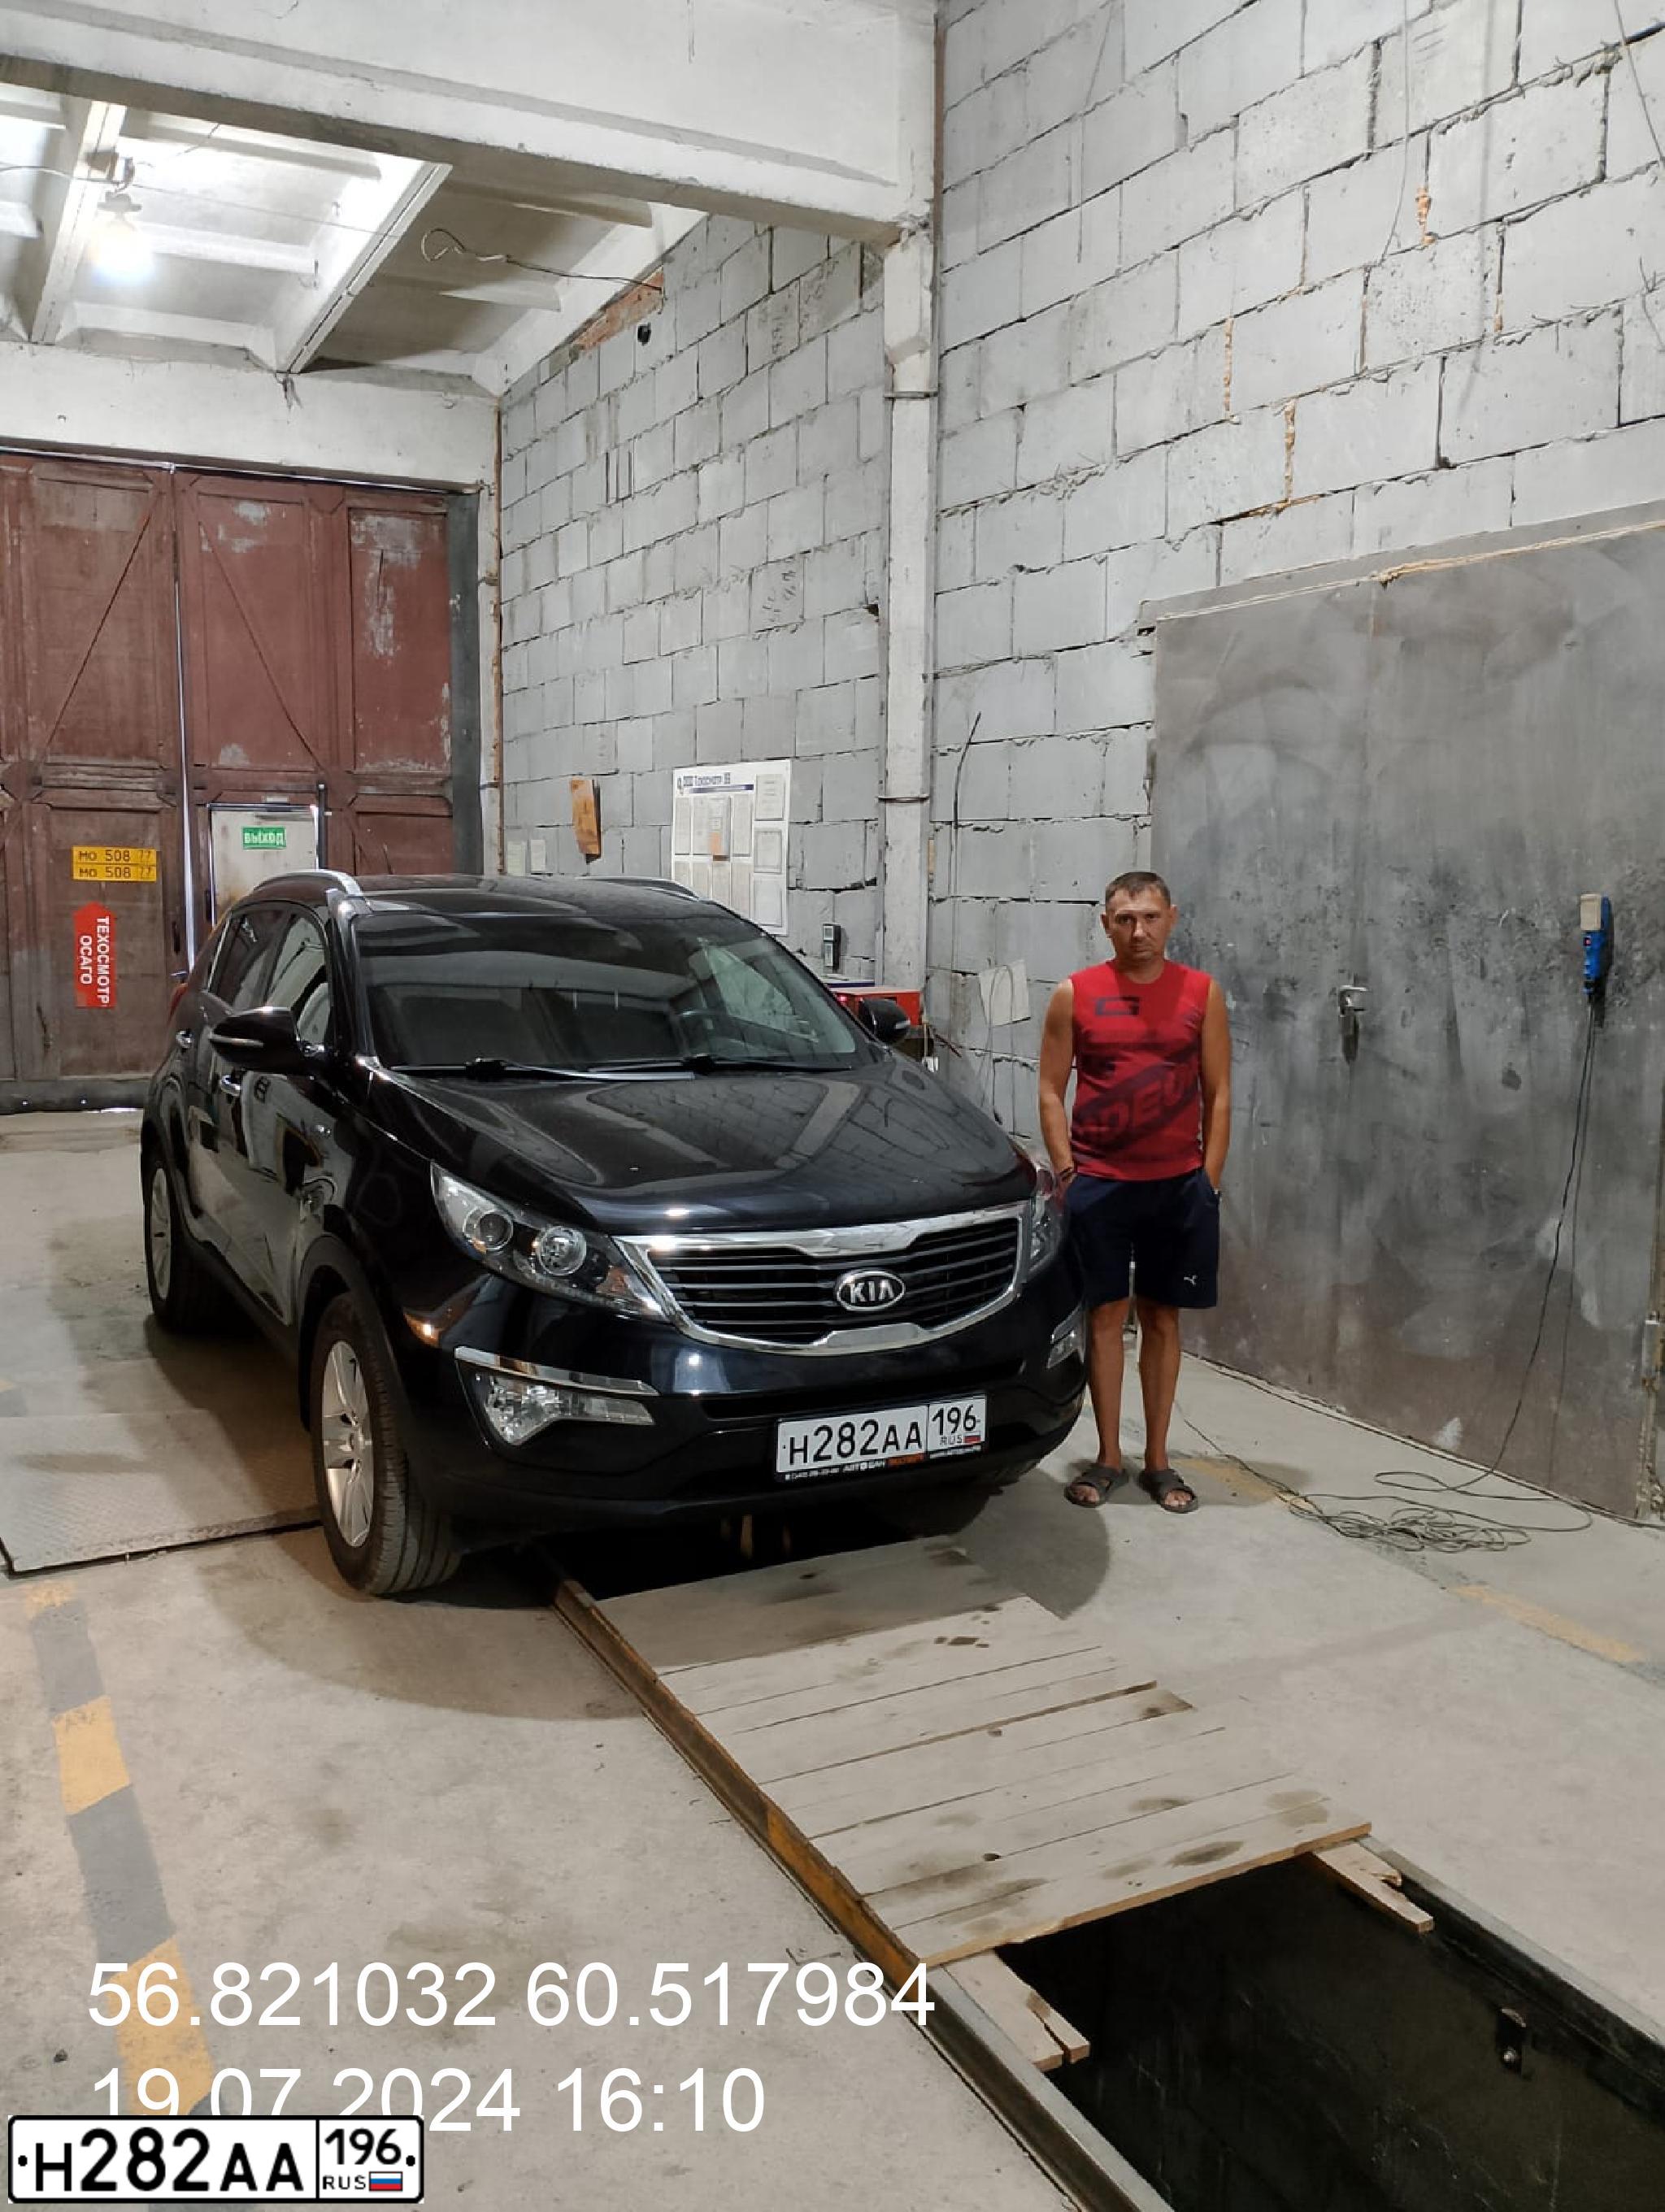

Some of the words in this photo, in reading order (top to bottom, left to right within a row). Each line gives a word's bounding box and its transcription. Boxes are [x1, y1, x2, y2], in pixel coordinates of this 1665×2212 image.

[105, 849, 130, 863] 508
[105, 866, 131, 879] 508
[80, 935, 93, 984] ОСАГО
[97, 915, 111, 1004] ТЕХОСМОТР
[850, 1279, 894, 1304] KIA
[932, 1403, 977, 1436] 196
[940, 1434, 963, 1445] RUS
